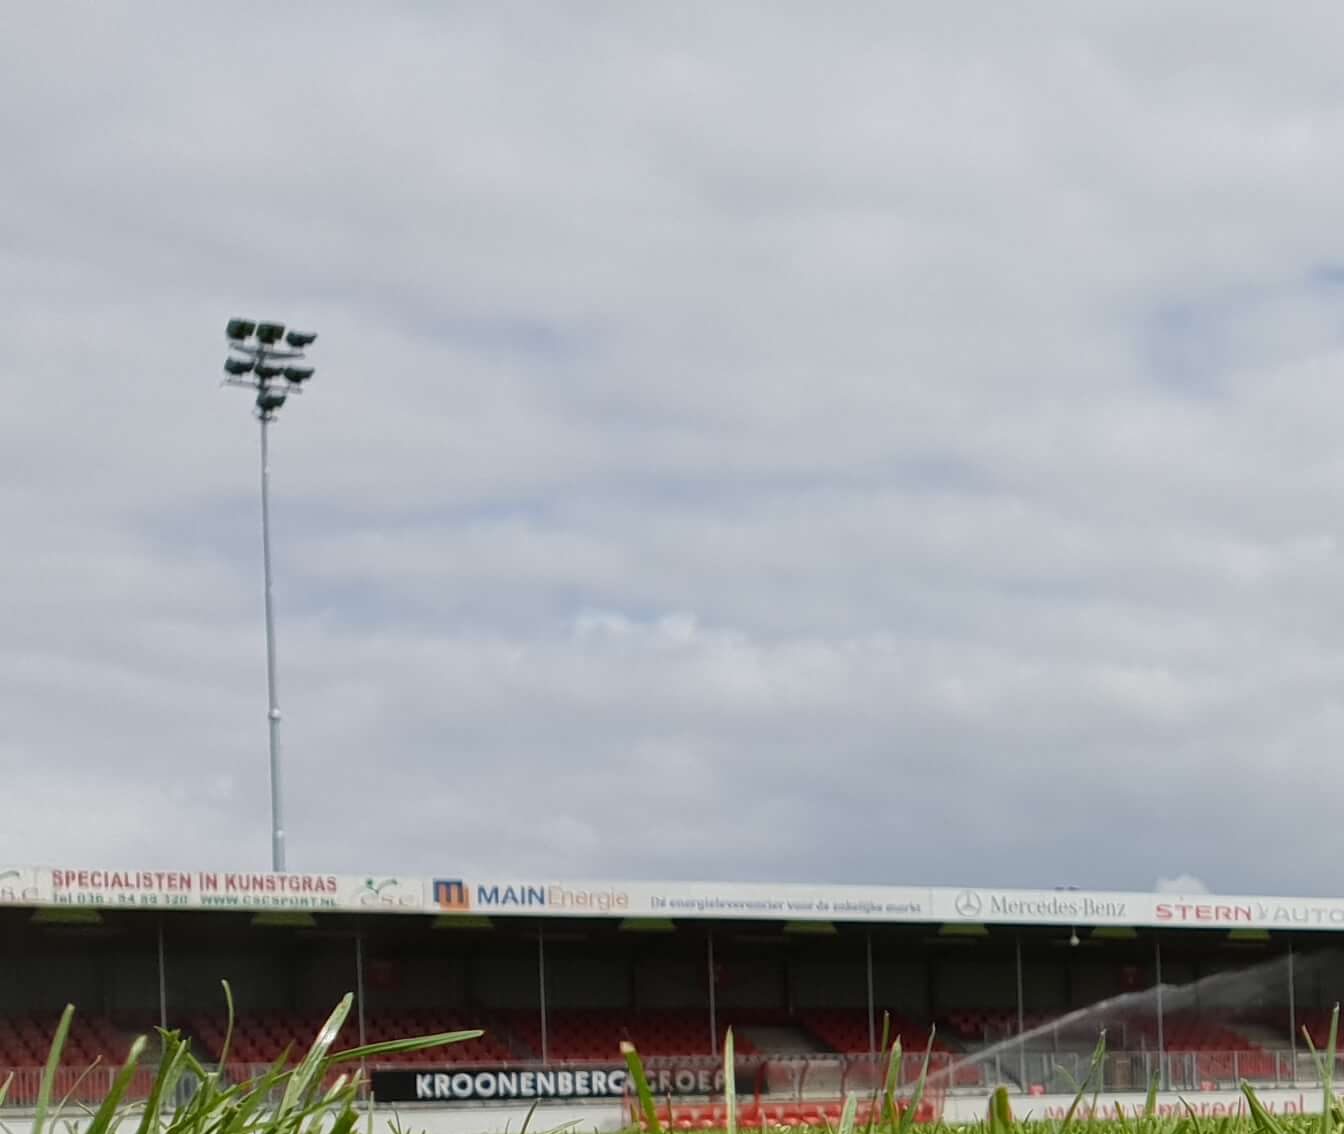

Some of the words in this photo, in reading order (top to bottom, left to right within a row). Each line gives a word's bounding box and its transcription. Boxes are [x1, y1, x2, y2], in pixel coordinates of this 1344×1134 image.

[52, 870, 192, 891] SPECIALISTEN
[199, 873, 218, 891] IN
[225, 874, 337, 893] KUNSTGRAS
[991, 895, 1127, 918] Mercedes-Benz
[1155, 903, 1251, 921] STERN
[415, 1070, 626, 1098] KROONENBERG
